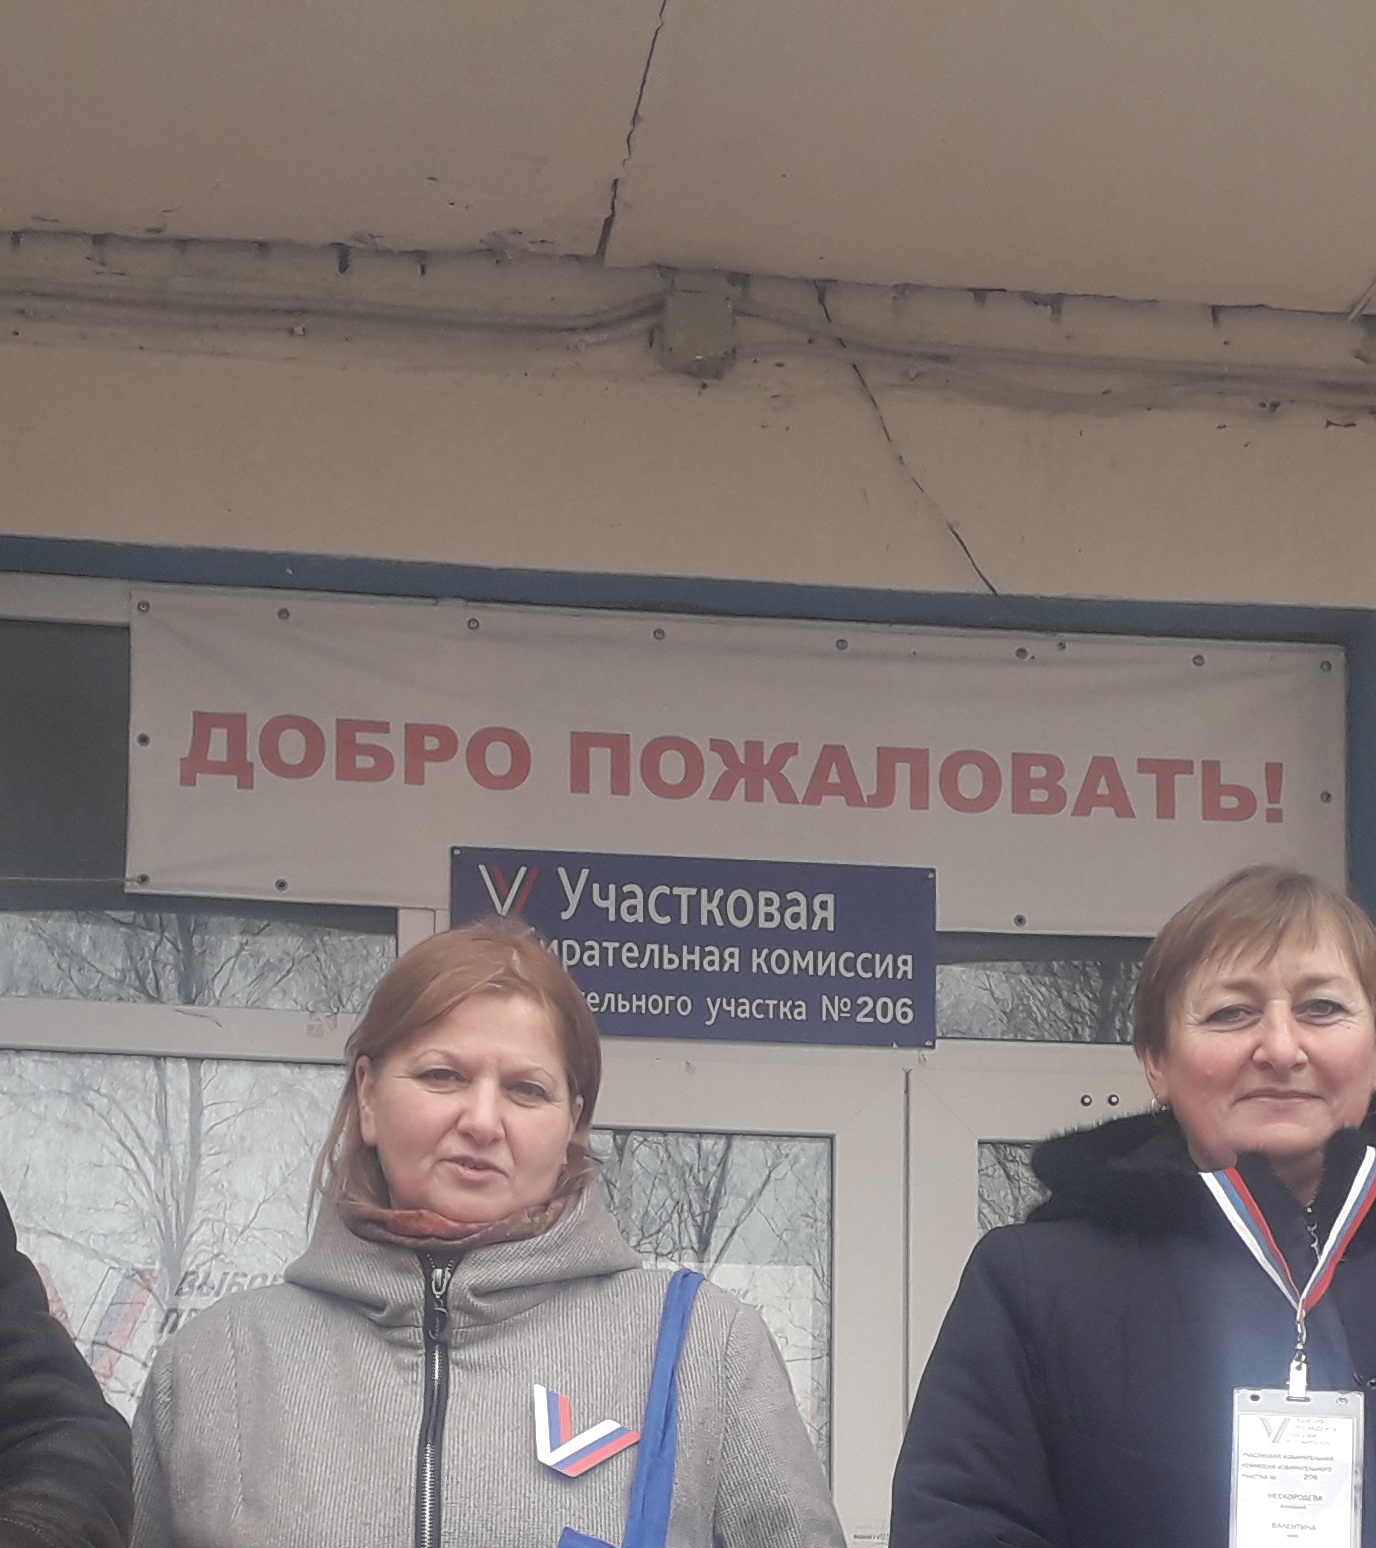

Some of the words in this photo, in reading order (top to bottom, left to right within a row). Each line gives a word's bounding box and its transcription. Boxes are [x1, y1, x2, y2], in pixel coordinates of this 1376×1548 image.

[179, 710, 531, 791] ДОБРО
[569, 731, 1284, 824] ПОЖАЛОВАТЬ!
[556, 866, 836, 931] Участковая
[539, 938, 740, 974] ирательная
[751, 947, 914, 980] комиссия
[705, 994, 807, 1026] участка
